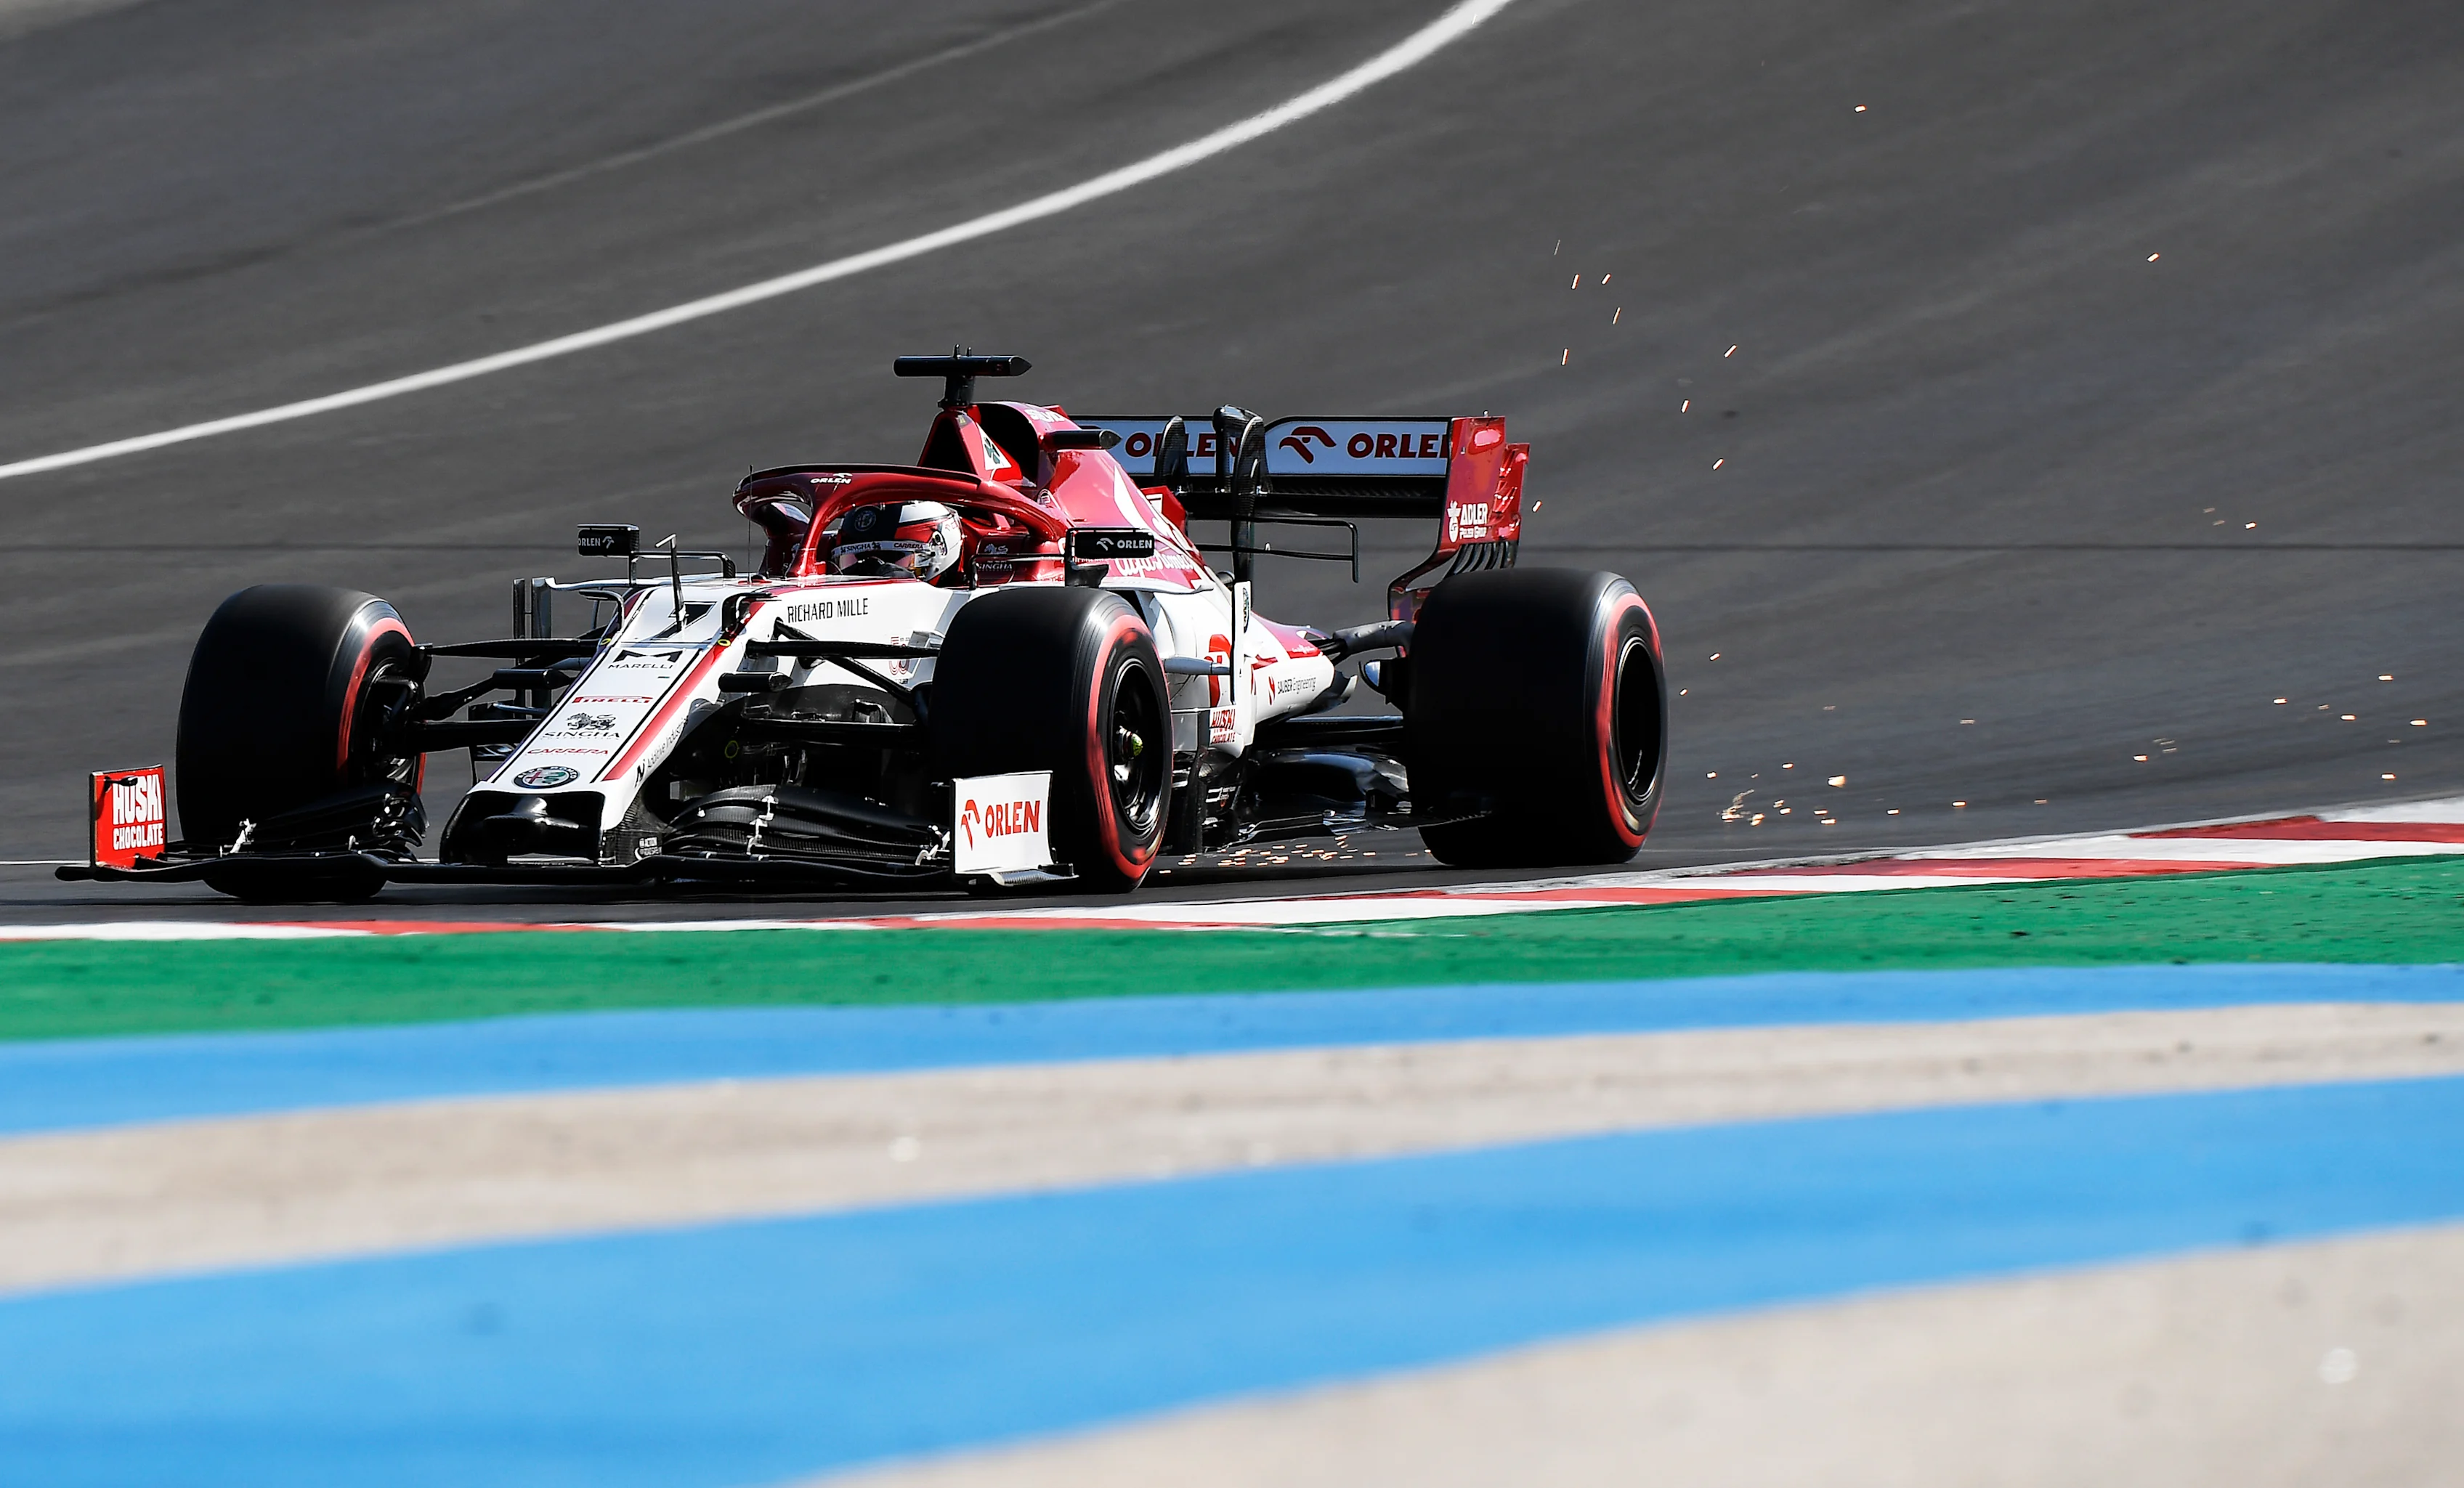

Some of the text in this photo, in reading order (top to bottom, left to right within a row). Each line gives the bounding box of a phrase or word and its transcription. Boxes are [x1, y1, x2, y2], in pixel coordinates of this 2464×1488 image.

[1348, 433, 1448, 458] ORLE
[1459, 503, 1488, 526] ADLER
[578, 538, 601, 547] ORLEN
[846, 542, 872, 552] SINGHA
[1116, 539, 1152, 549] ORLEN
[787, 598, 869, 624] RICHARD MILLE
[572, 695, 654, 704] PIRELLI
[112, 774, 163, 826] HUSKI
[985, 800, 1041, 839] ORLEN
[112, 822, 164, 851] CHOCOLATE
